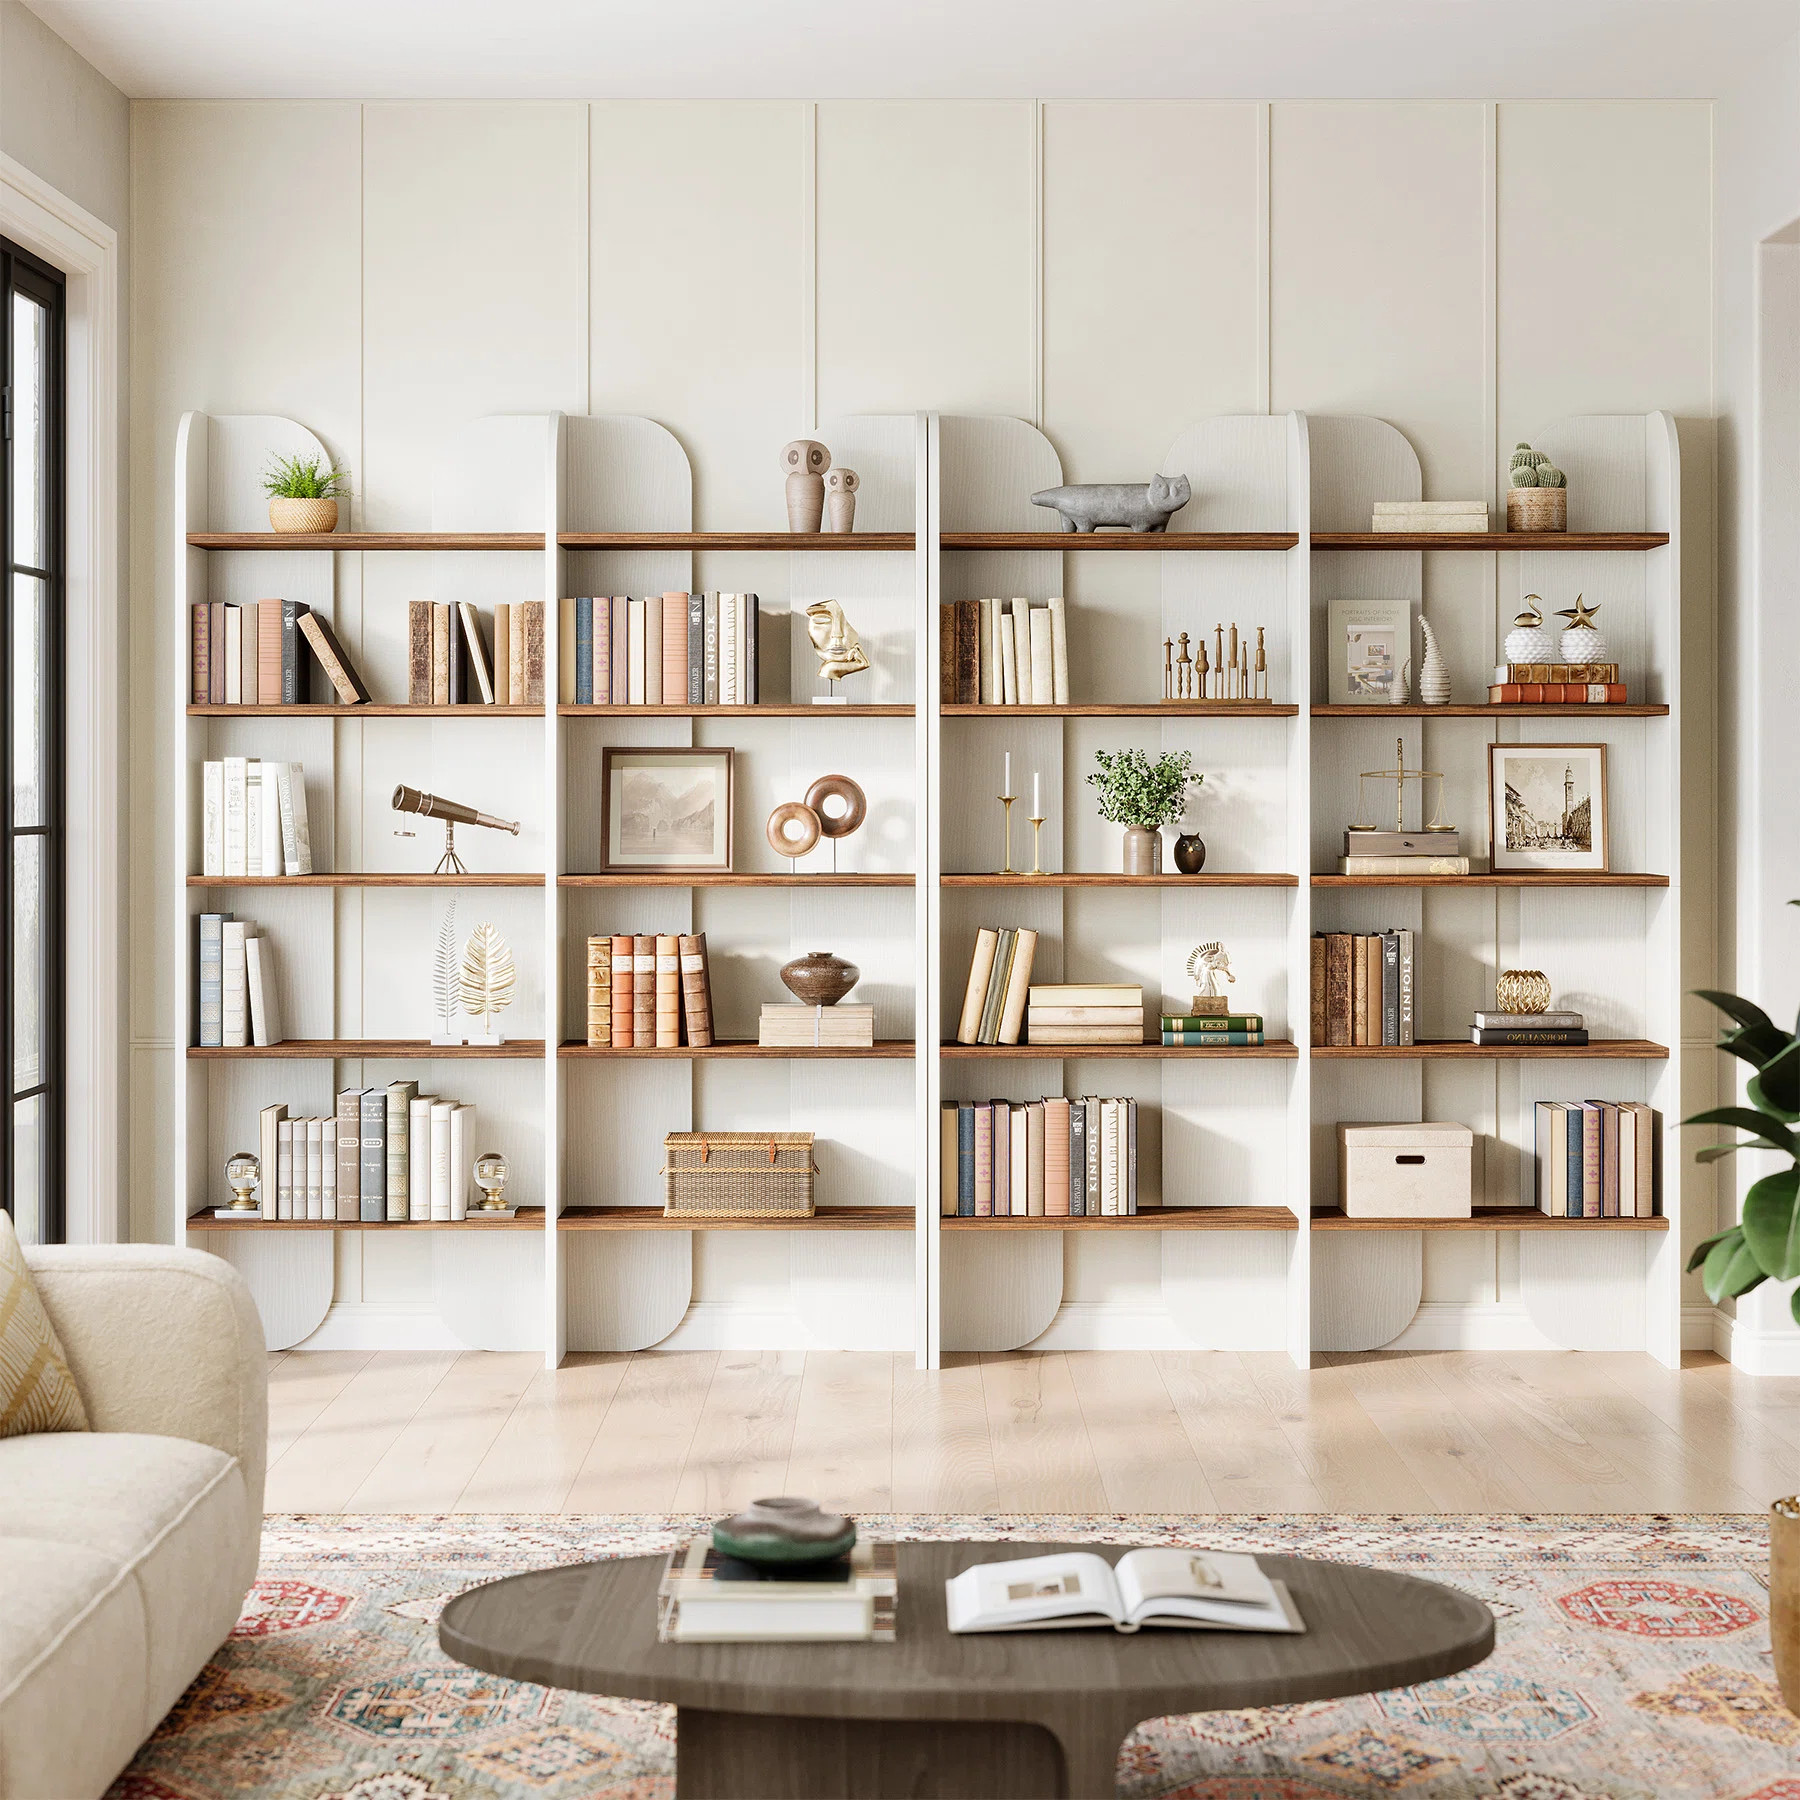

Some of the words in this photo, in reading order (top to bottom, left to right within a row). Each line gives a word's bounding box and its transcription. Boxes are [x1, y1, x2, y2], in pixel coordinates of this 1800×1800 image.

[707, 615, 715, 681] KINFOLK
[1403, 955, 1411, 1022] KINFOLK
[1089, 1126, 1097, 1192] KINFOLK
